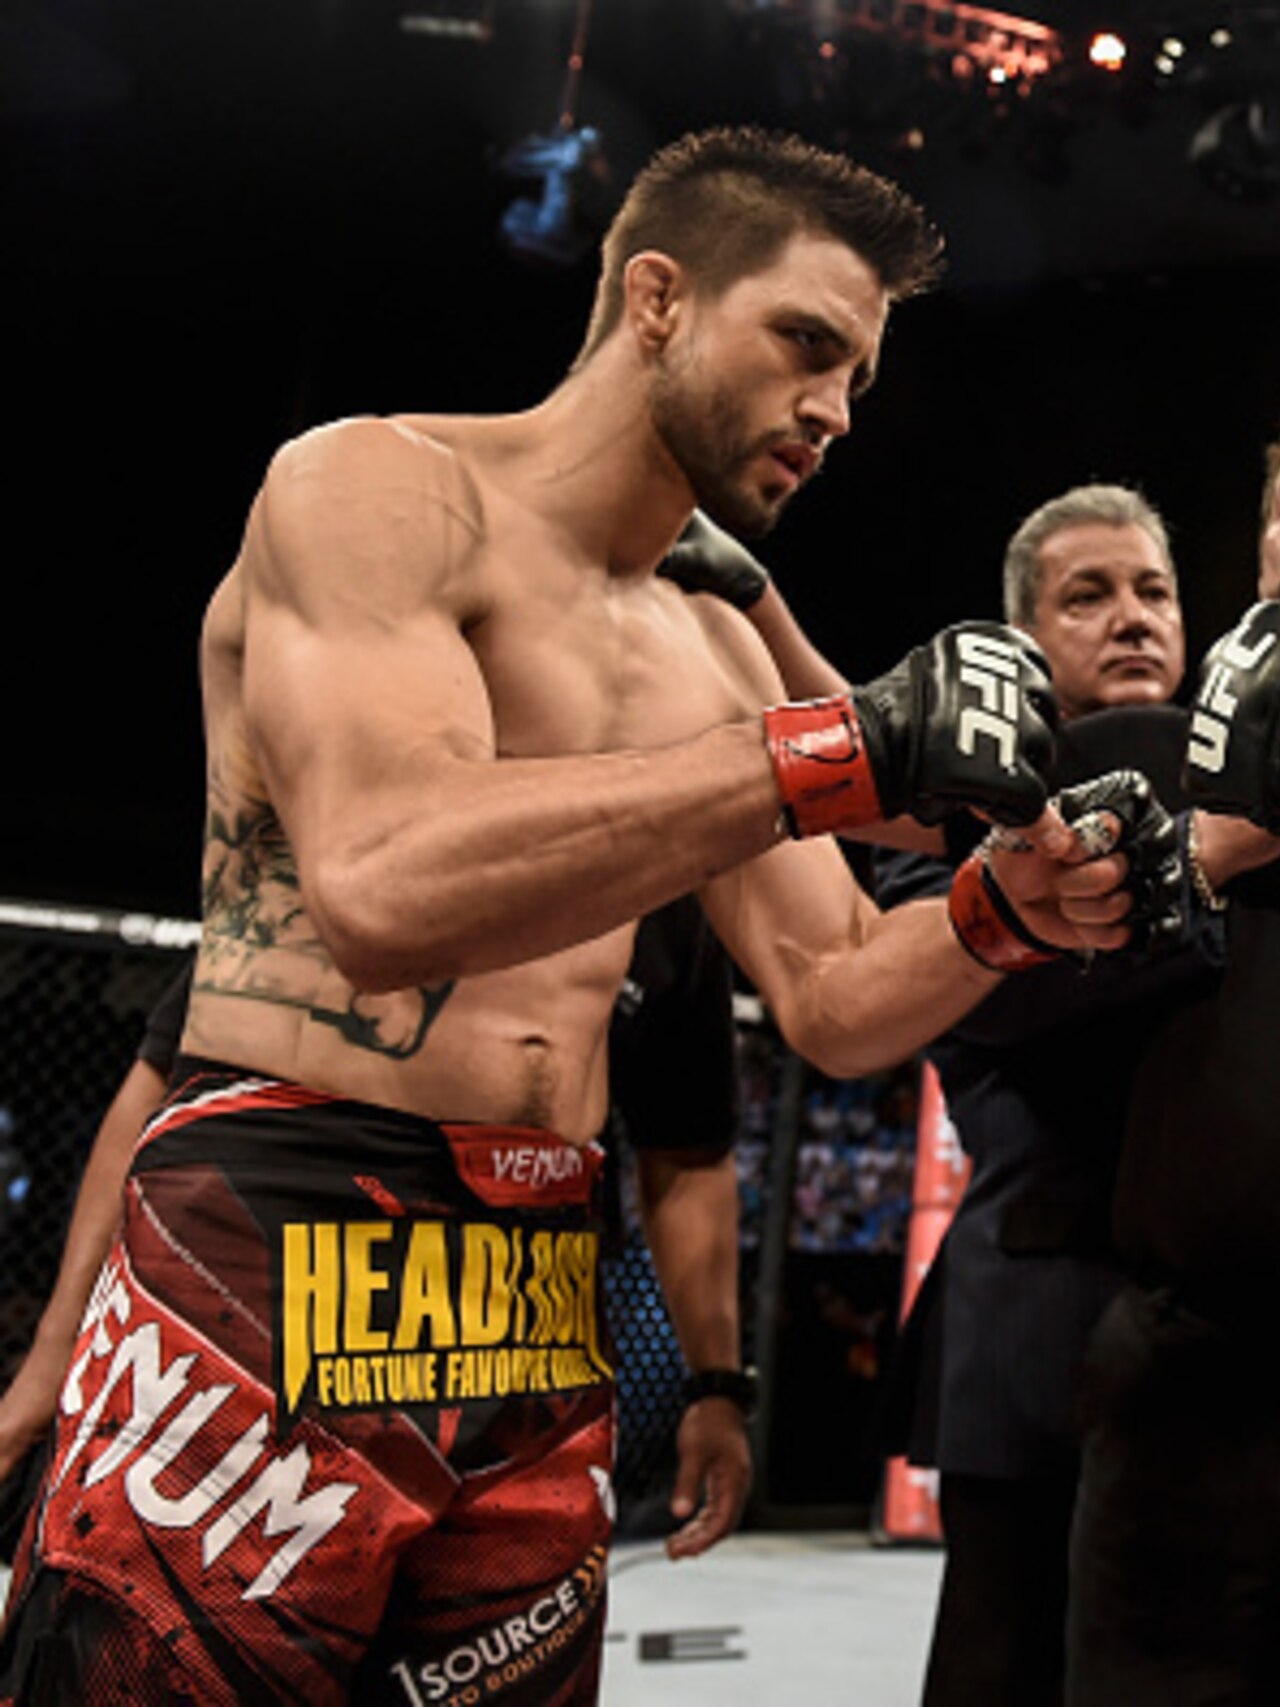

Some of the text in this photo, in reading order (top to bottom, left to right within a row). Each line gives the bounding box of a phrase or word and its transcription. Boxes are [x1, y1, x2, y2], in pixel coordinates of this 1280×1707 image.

[956, 632, 1019, 769] UFC
[1188, 618, 1277, 773] UFC
[317, 1353, 438, 1406] FORTUNE
